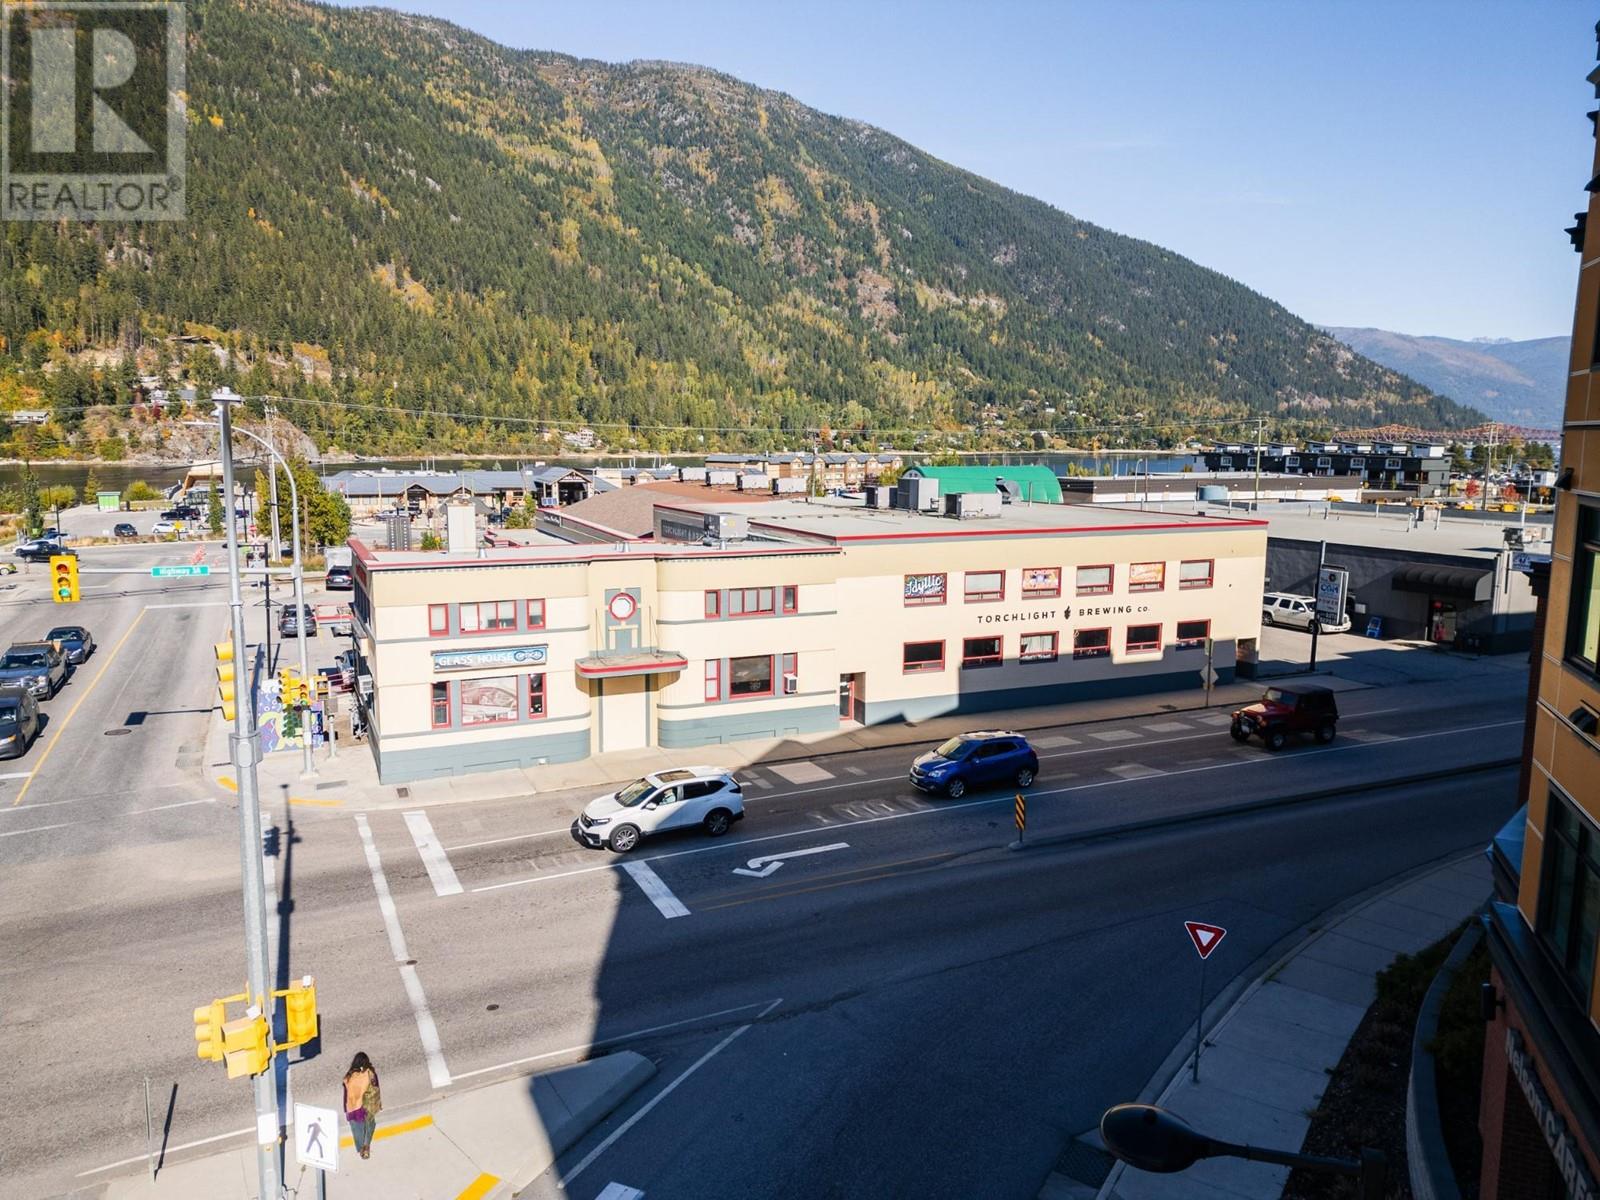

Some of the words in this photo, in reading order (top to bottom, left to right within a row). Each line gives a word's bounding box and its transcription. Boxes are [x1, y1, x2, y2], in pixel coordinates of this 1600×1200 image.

[977, 610, 1056, 624] TORCHLIGHT
[1079, 605, 1133, 617] BREWING
[439, 656, 473, 667] GLASS
[478, 653, 513, 664] HOUSE
[1505, 1027, 1543, 1129] Nelson
[1545, 1109, 1593, 1200] CARE
